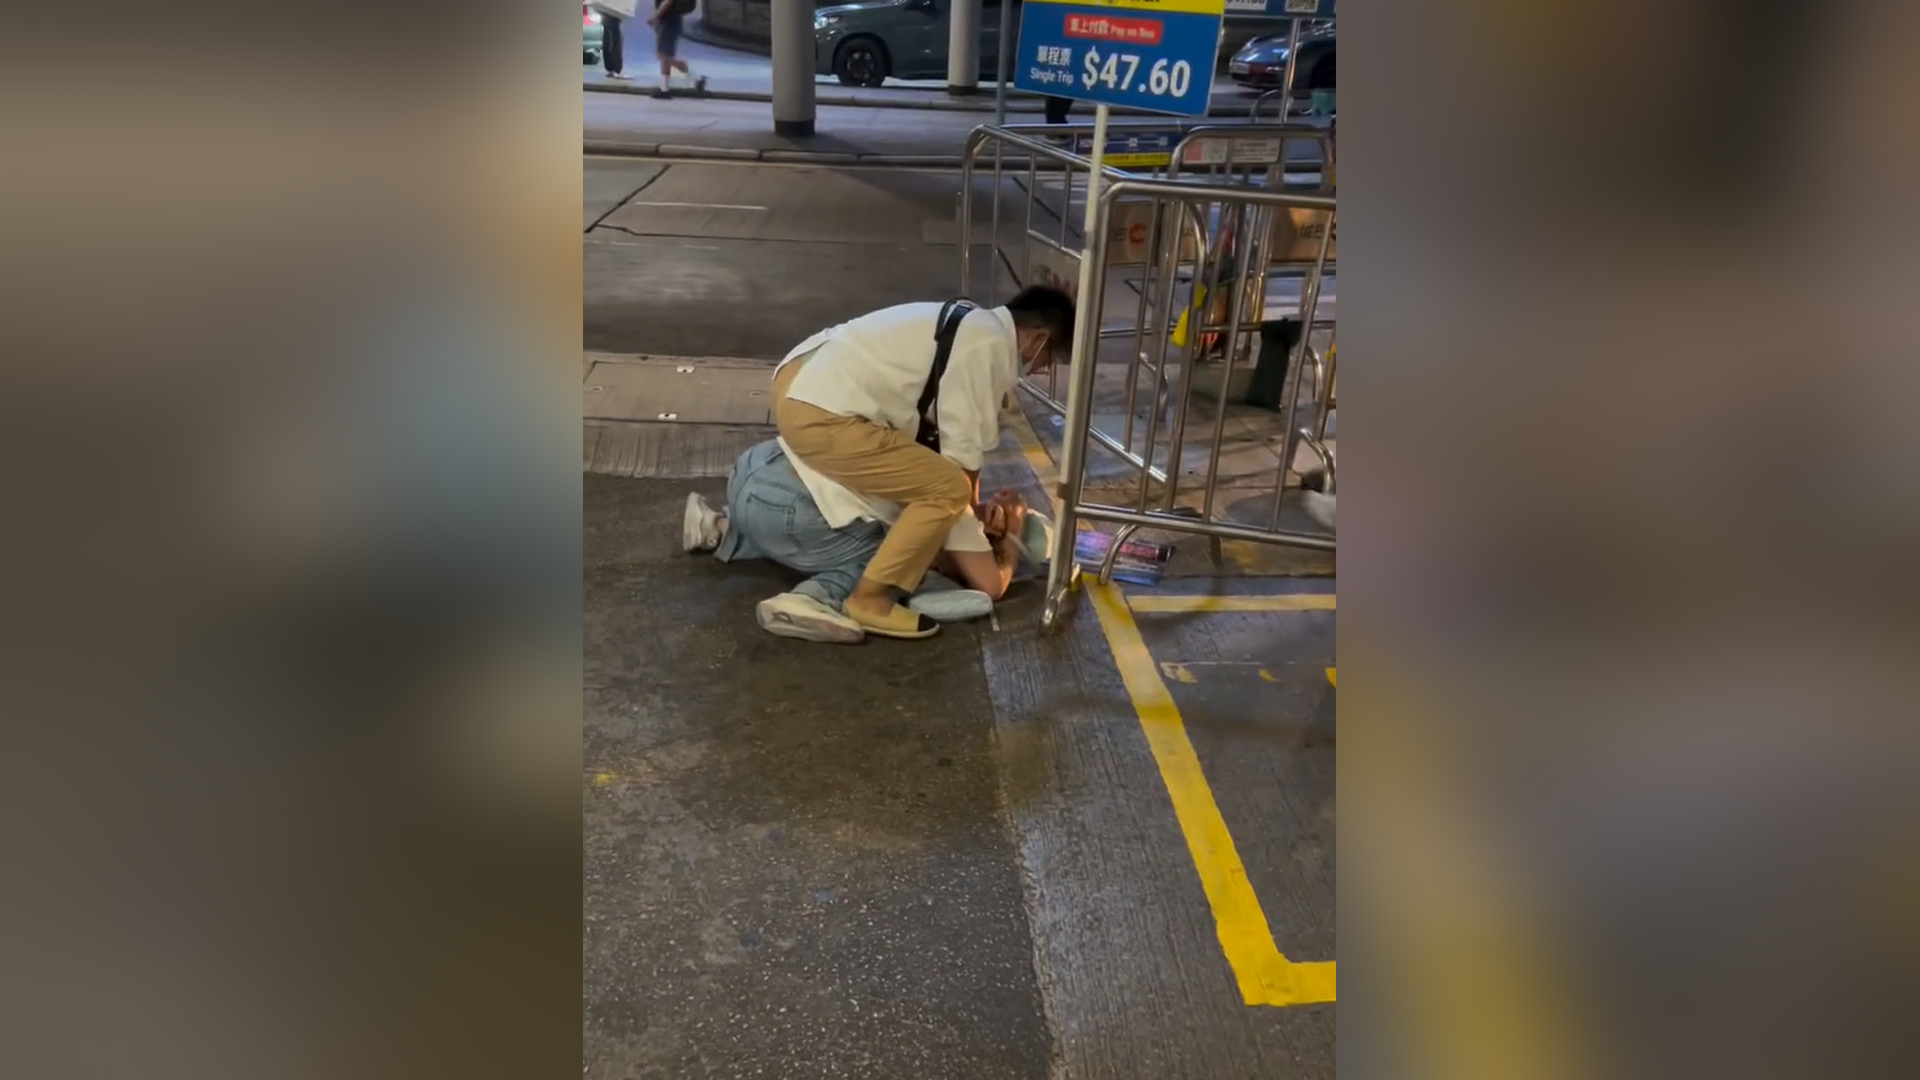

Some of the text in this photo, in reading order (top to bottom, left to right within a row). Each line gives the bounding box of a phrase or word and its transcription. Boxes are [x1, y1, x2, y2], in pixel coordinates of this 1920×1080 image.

[1037, 45, 1072, 66] 單程票
[1030, 66, 1074, 86] Single Trip
[1082, 45, 1191, 97] $47.60
